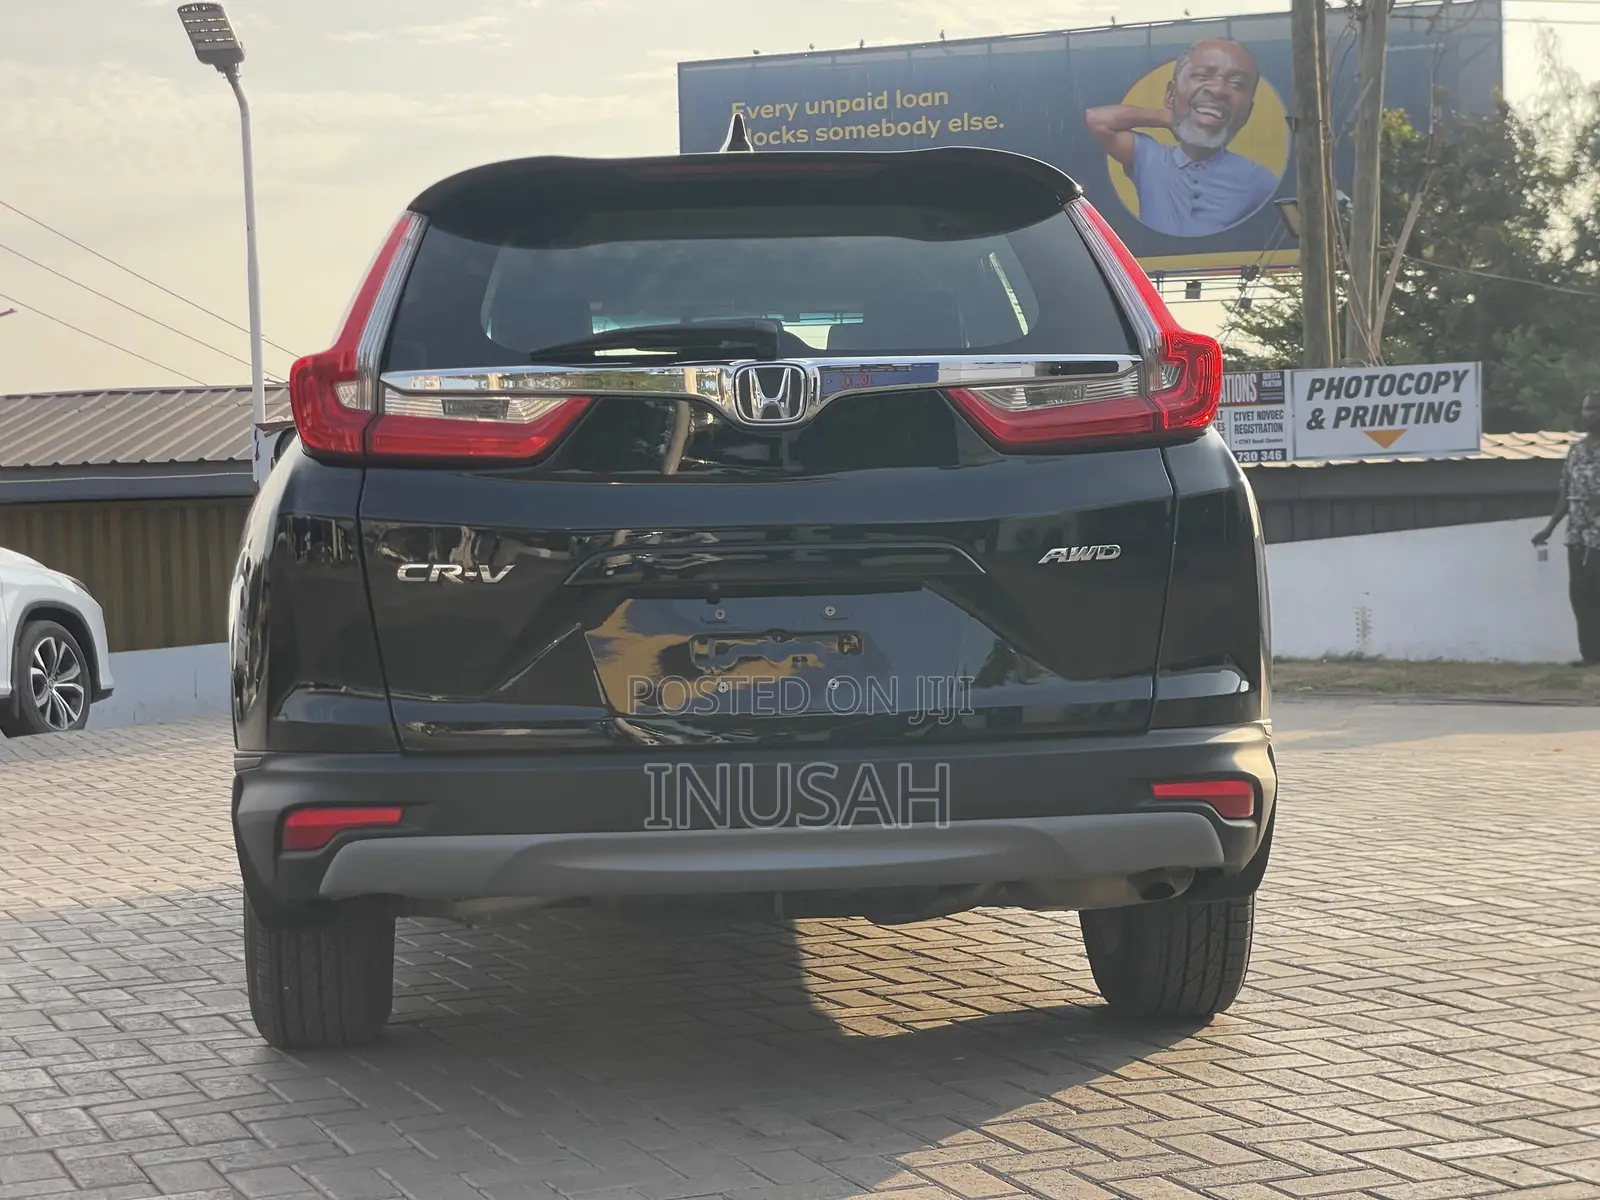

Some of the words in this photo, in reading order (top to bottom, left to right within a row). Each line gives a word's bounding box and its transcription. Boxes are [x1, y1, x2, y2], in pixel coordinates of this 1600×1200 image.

[731, 102, 798, 121] Every
[805, 91, 888, 117] unpaid
[896, 89, 949, 109] loan
[745, 125, 809, 146] locks
[815, 116, 941, 142] somebody
[948, 112, 1004, 132] else.
[1219, 373, 1257, 403] ATIONS
[1307, 370, 1469, 401] PHOTOCOPY
[1234, 422, 1283, 435] REGISTRATION
[1306, 408, 1326, 430] &
[1332, 400, 1462, 429] PRINTING
[1237, 451, 1258, 462] 730
[1260, 450, 1282, 461] 346
[1038, 544, 1121, 564] AWD
[397, 564, 516, 583] CR-V
